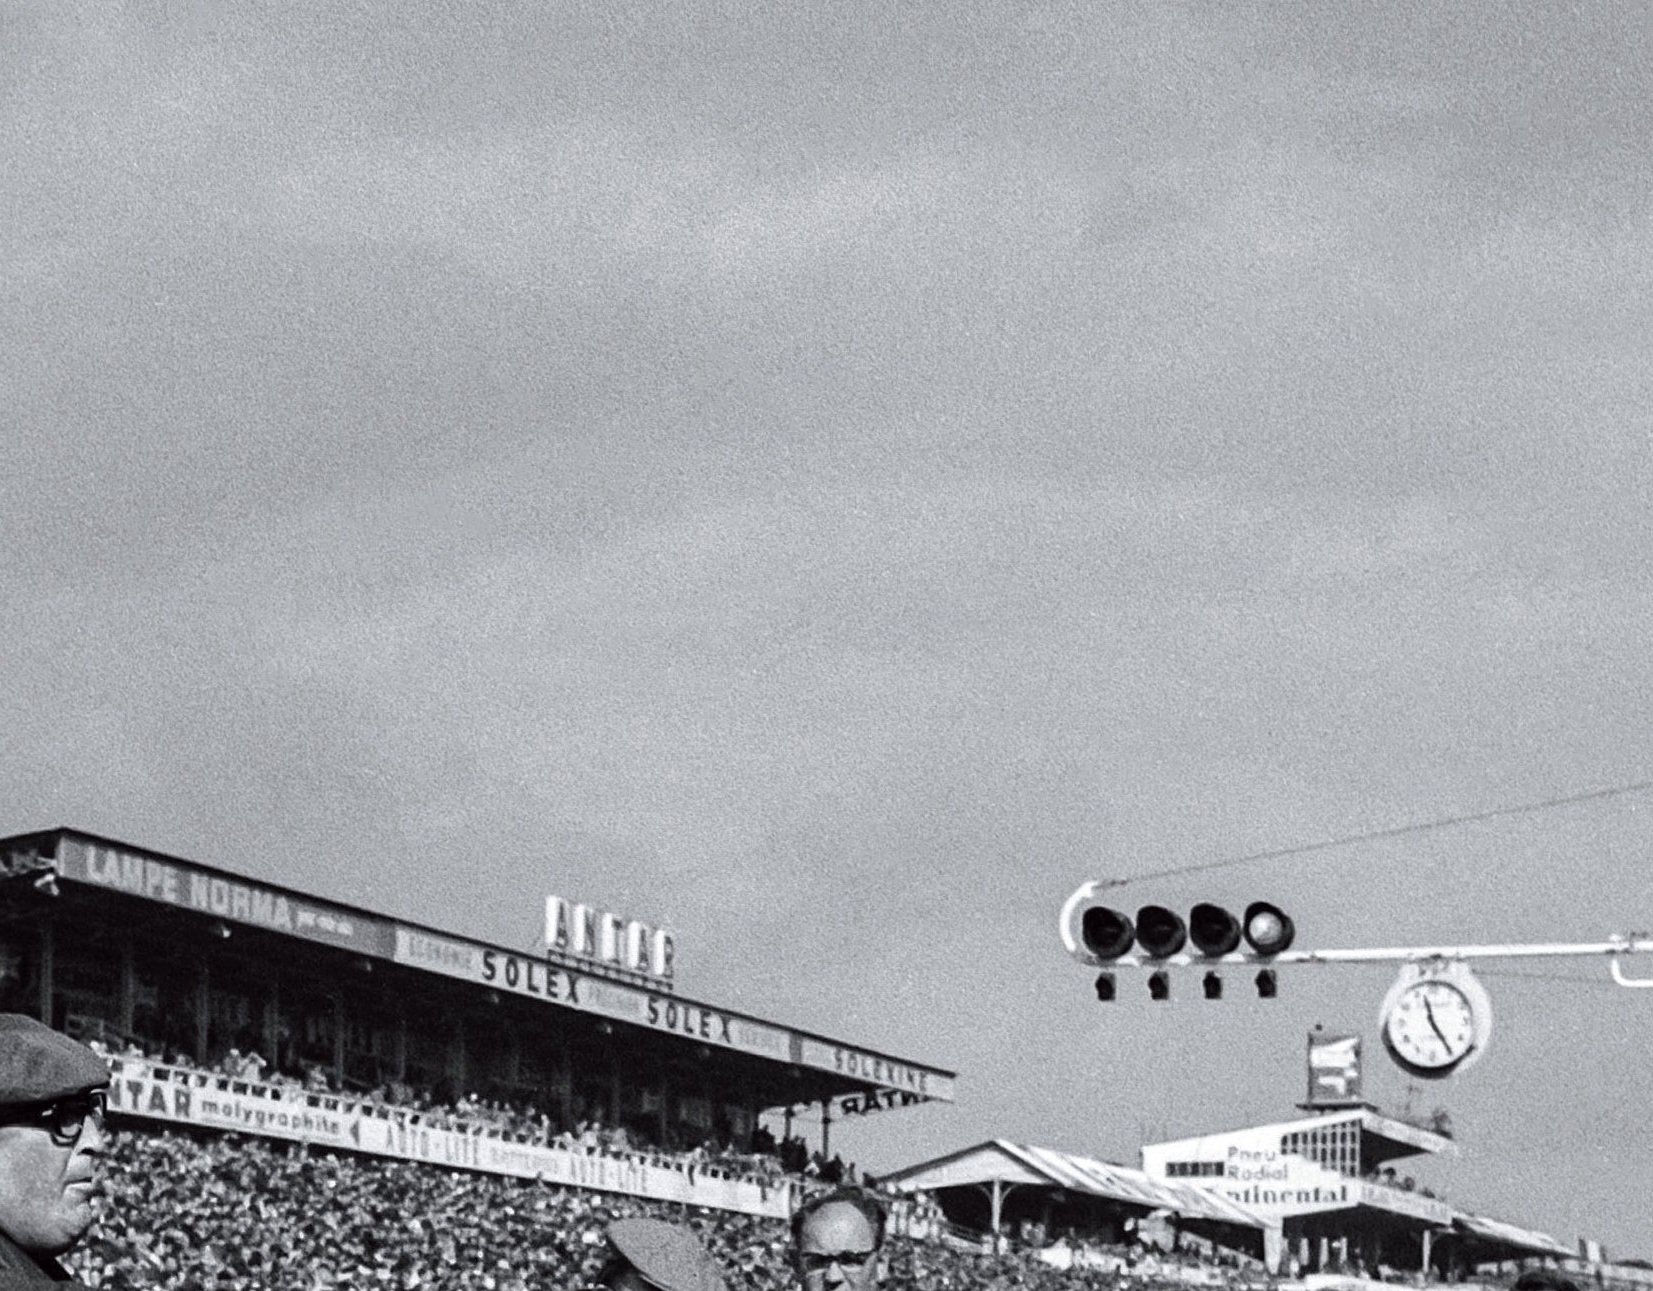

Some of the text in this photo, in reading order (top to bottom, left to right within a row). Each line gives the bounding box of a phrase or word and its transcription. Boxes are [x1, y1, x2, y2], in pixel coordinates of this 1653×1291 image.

[86, 845, 180, 902] LAMPE
[190, 872, 294, 930] NORMA
[481, 950, 579, 1003] SOLEX
[647, 997, 731, 1043] SOLEX
